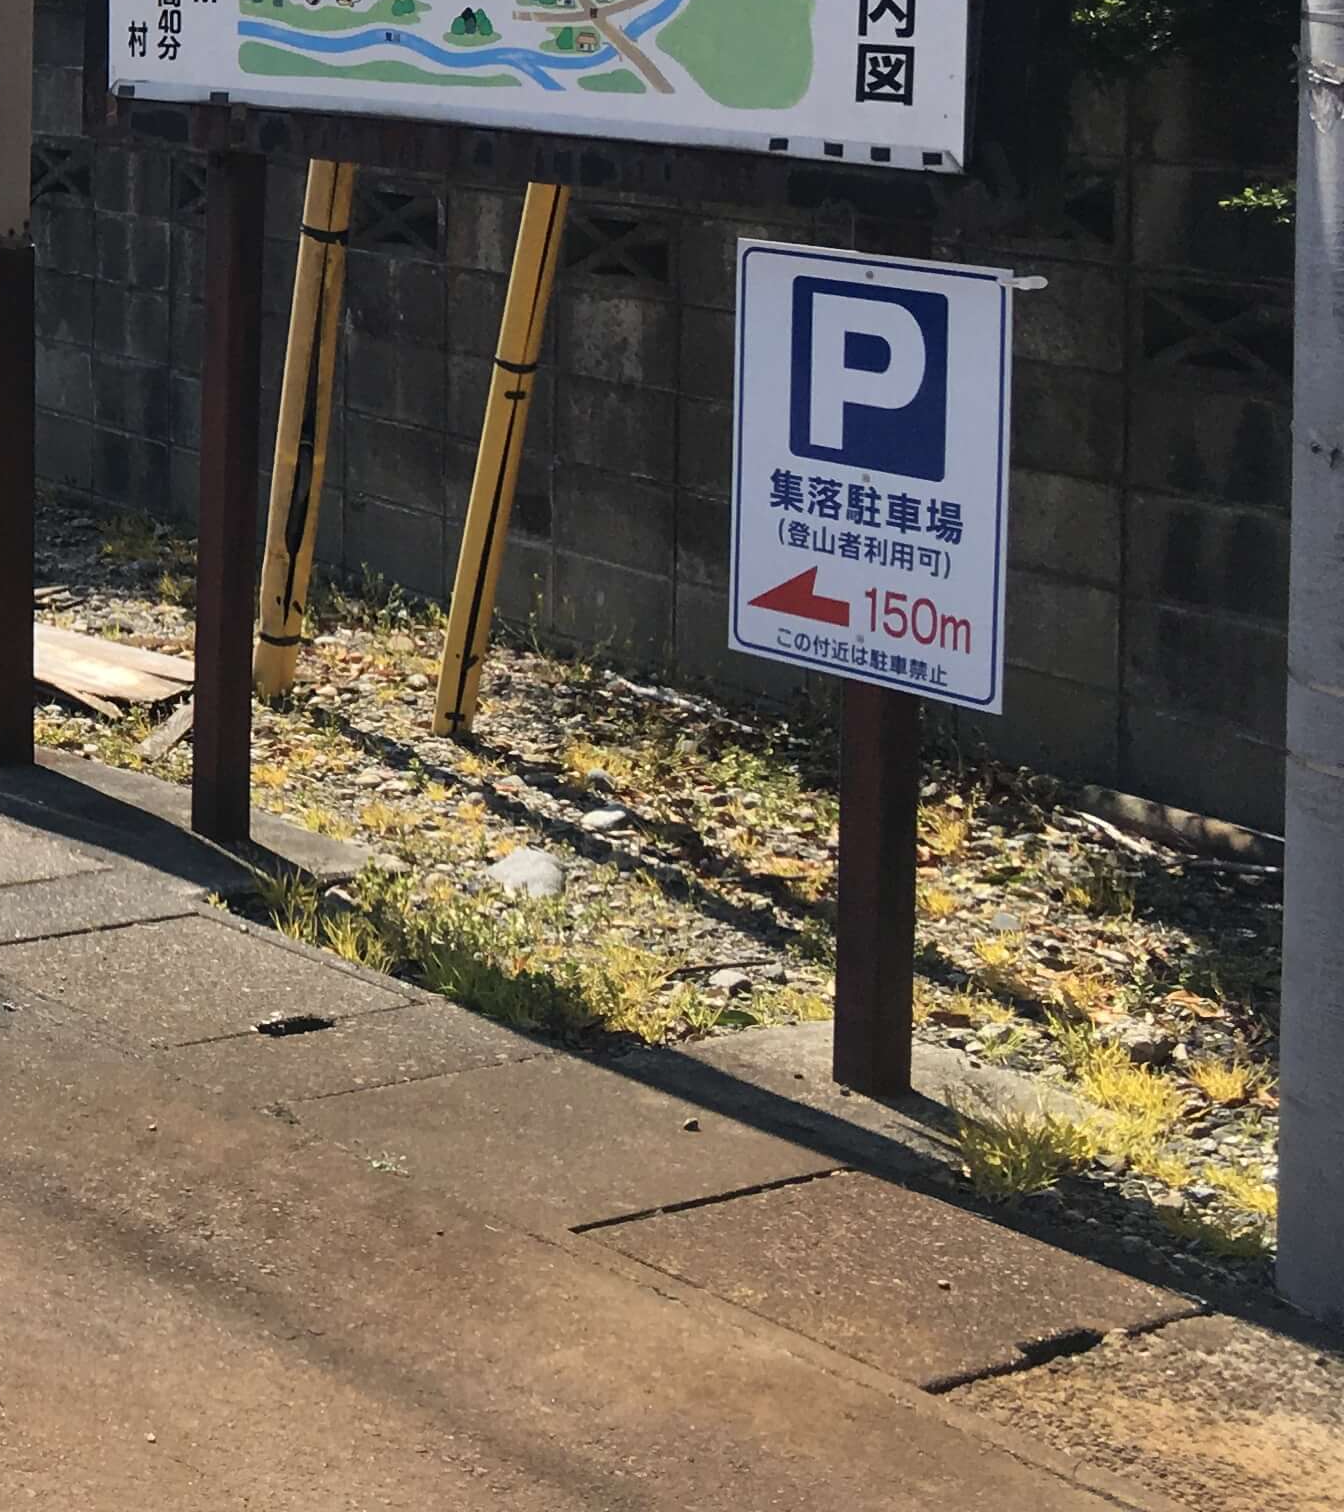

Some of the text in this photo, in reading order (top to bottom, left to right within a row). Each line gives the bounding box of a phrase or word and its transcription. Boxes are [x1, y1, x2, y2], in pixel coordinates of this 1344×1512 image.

[808, 292, 926, 450] P
[769, 468, 963, 545] 集落駐車場
[864, 587, 972, 654] 150m
[776, 627, 949, 687] この付近は駐車禁止
